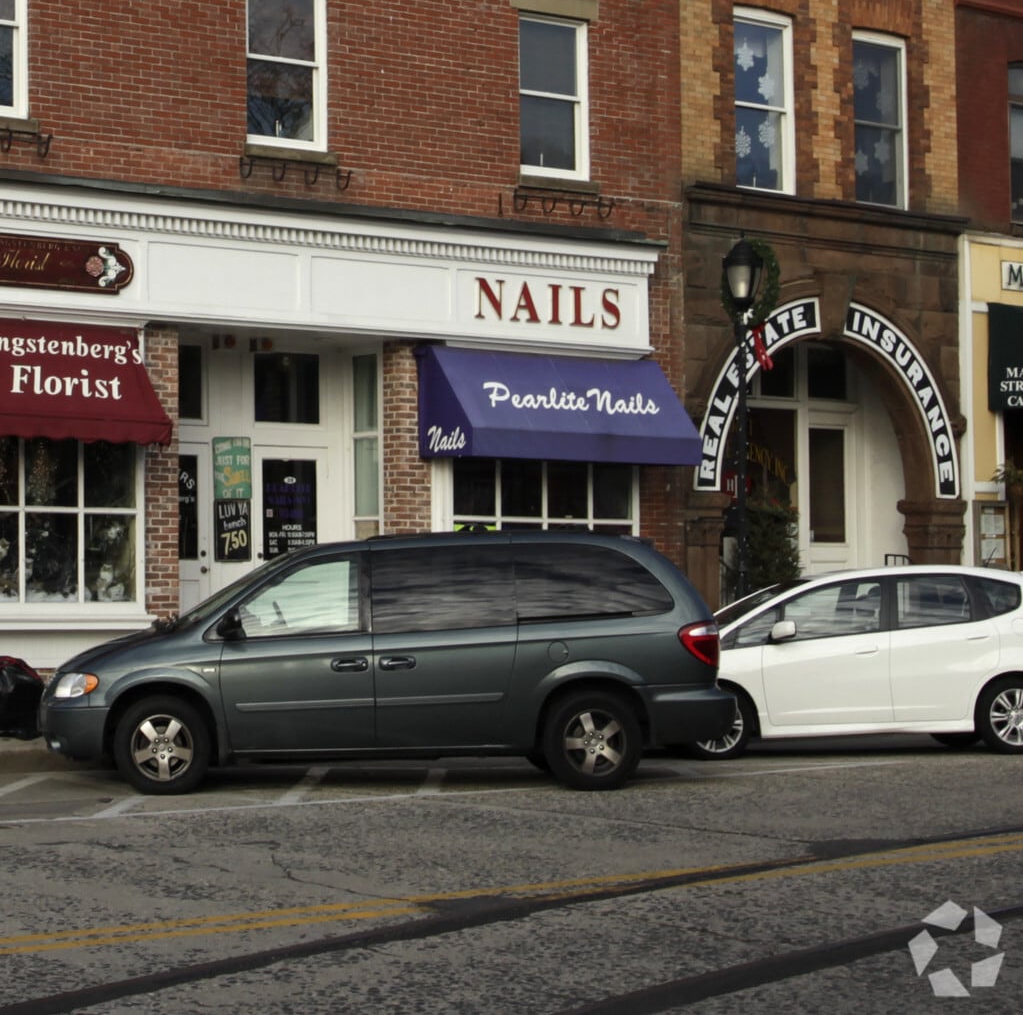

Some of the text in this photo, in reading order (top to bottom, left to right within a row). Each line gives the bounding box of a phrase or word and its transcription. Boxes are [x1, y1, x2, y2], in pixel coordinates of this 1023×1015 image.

[474, 277, 621, 330] NAILS
[10, 364, 123, 401] Florist
[587, 388, 660, 415] Nails
[853, 311, 954, 484] INSURANCE
[427, 425, 467, 453] Nails
[700, 394, 732, 480] REAL
[236, 455, 250, 466] FOR
[236, 488, 244, 499] IT
[218, 503, 236, 520] LUV
[237, 502, 248, 517] YA
[220, 529, 247, 556] 7.50
